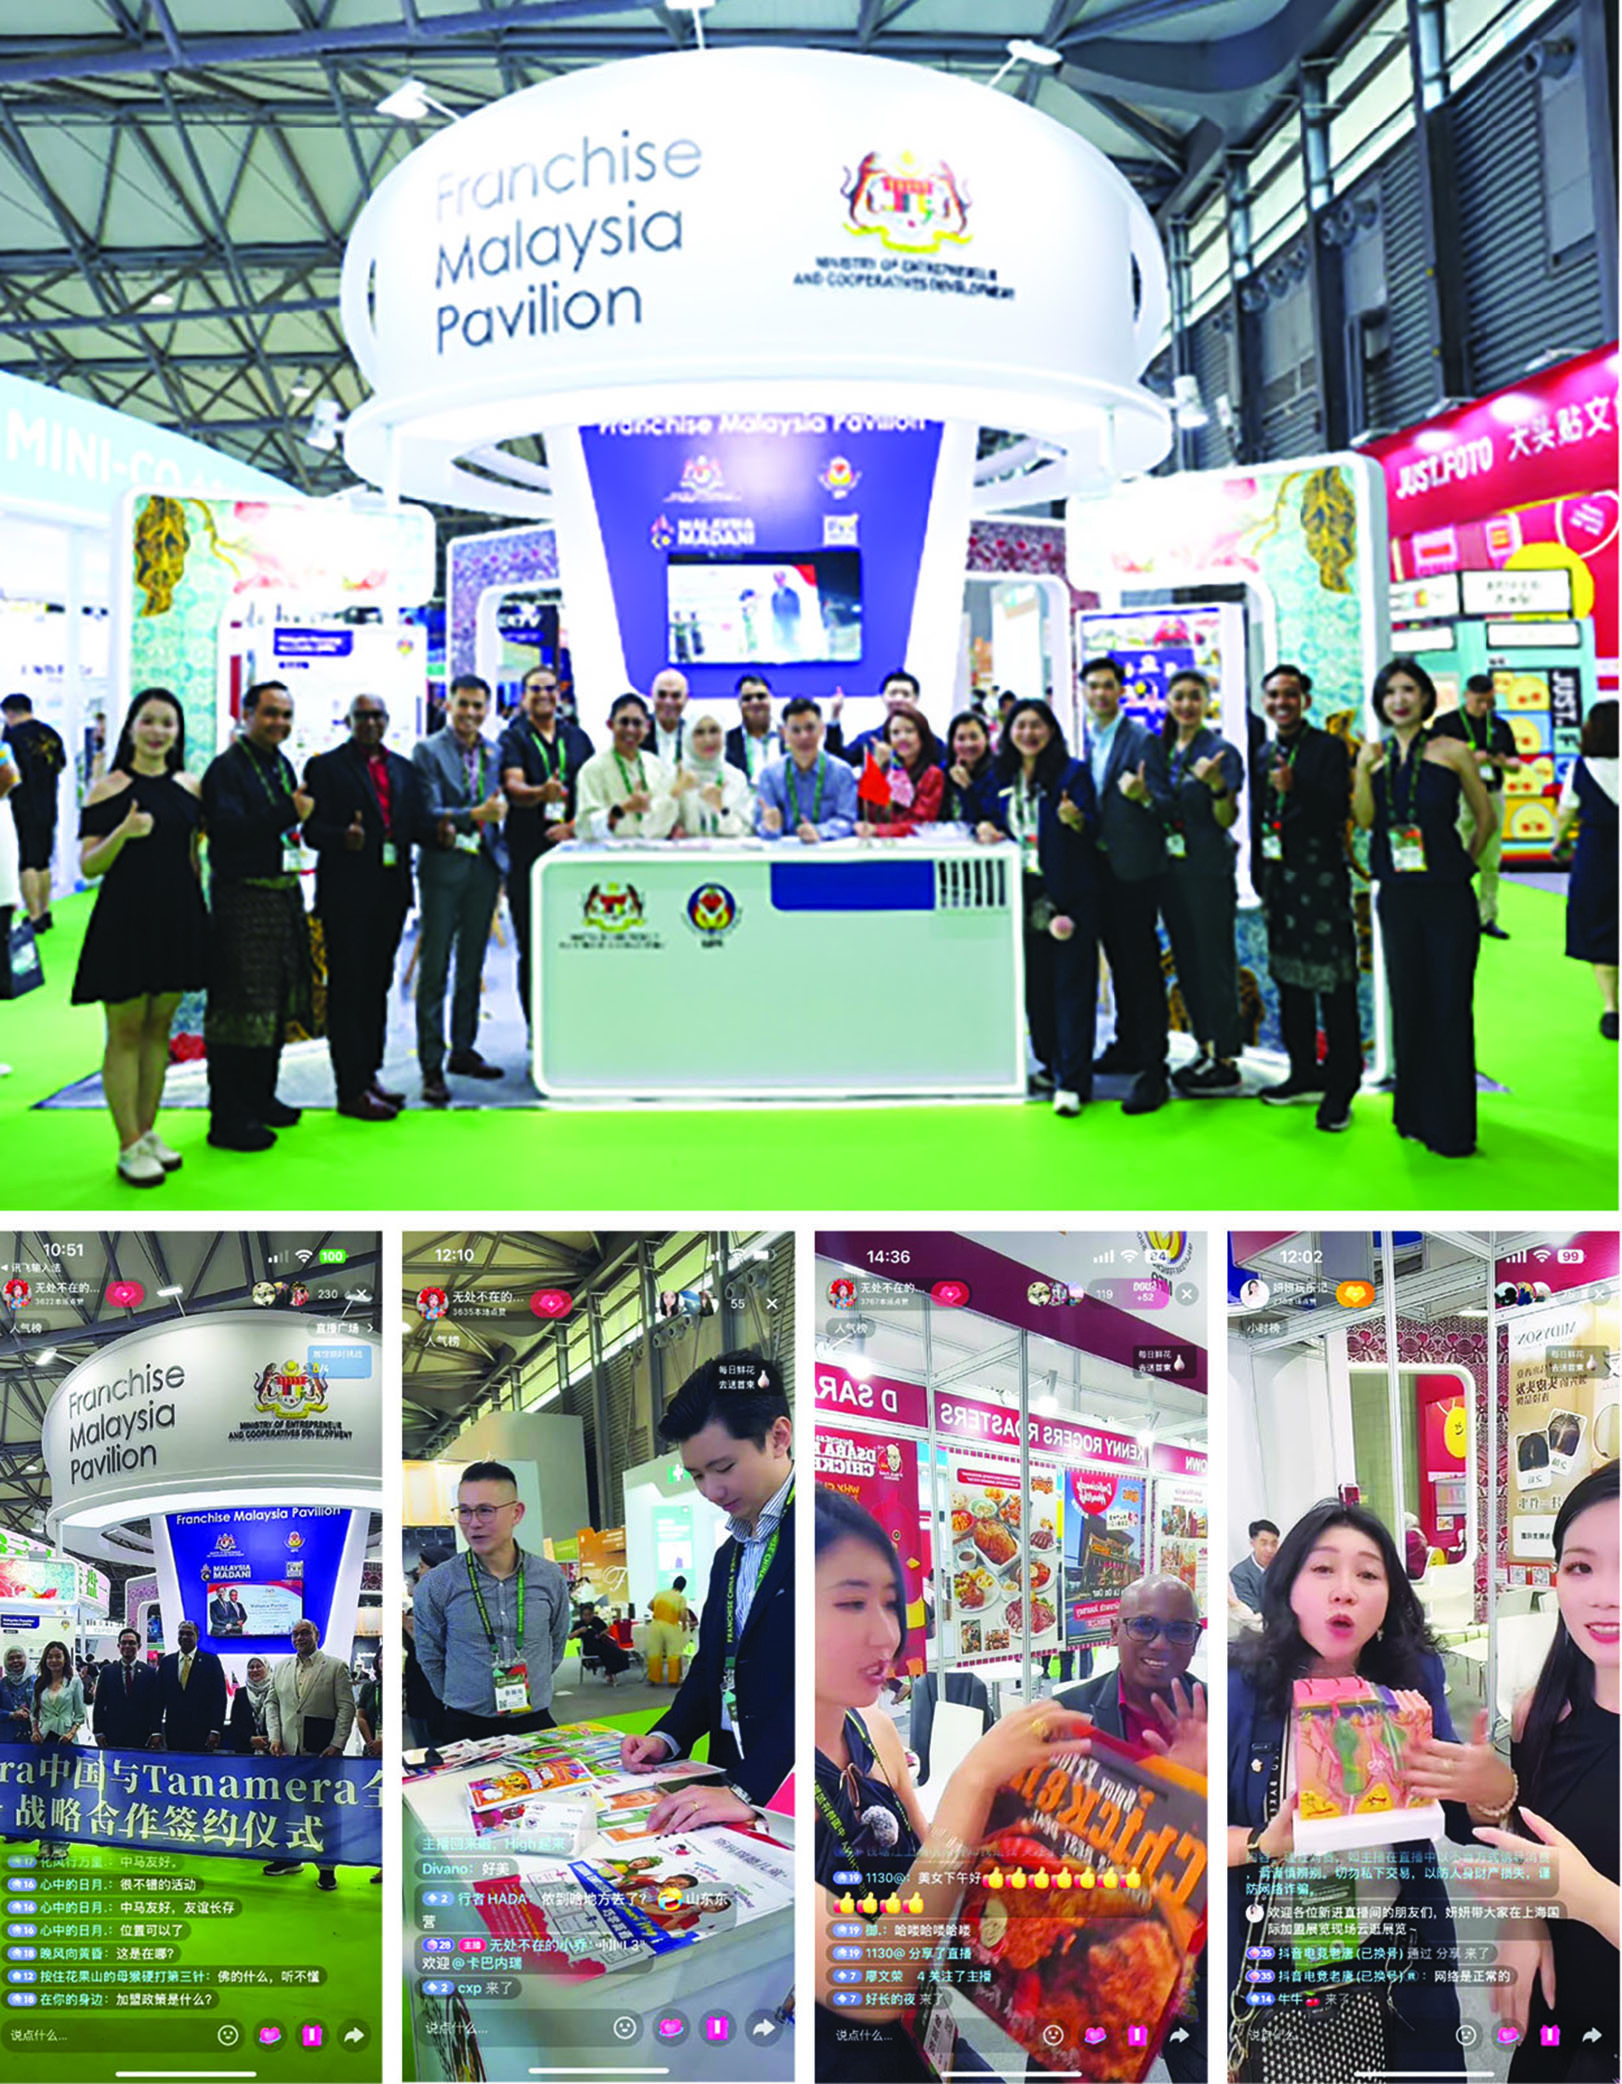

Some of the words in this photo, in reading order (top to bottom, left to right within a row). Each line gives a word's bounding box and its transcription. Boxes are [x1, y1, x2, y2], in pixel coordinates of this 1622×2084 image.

[436, 130, 702, 223] Franchise
[435, 200, 684, 289] Malaysia
[436, 285, 642, 354] Pavilion
[69, 1363, 185, 1418] Franchise
[70, 1400, 175, 1452] Malaysia
[228, 1431, 244, 1440] AND
[246, 1430, 301, 1439] COOPERATIVES
[302, 1430, 352, 1439] DEVELOPMENT
[240, 1421, 272, 1429] MINISTRY
[274, 1421, 283, 1429] OF
[286, 1421, 342, 1429] ENTREPRENEUR
[71, 1441, 157, 1483] Pavilion
[176, 1512, 231, 1525] Franchise
[233, 1509, 288, 1523] Malaysia
[292, 1507, 341, 1518] Pavilion
[213, 1571, 251, 1579] MADANI
[16, 1794, 324, 1852] 战略合作签约仪式
